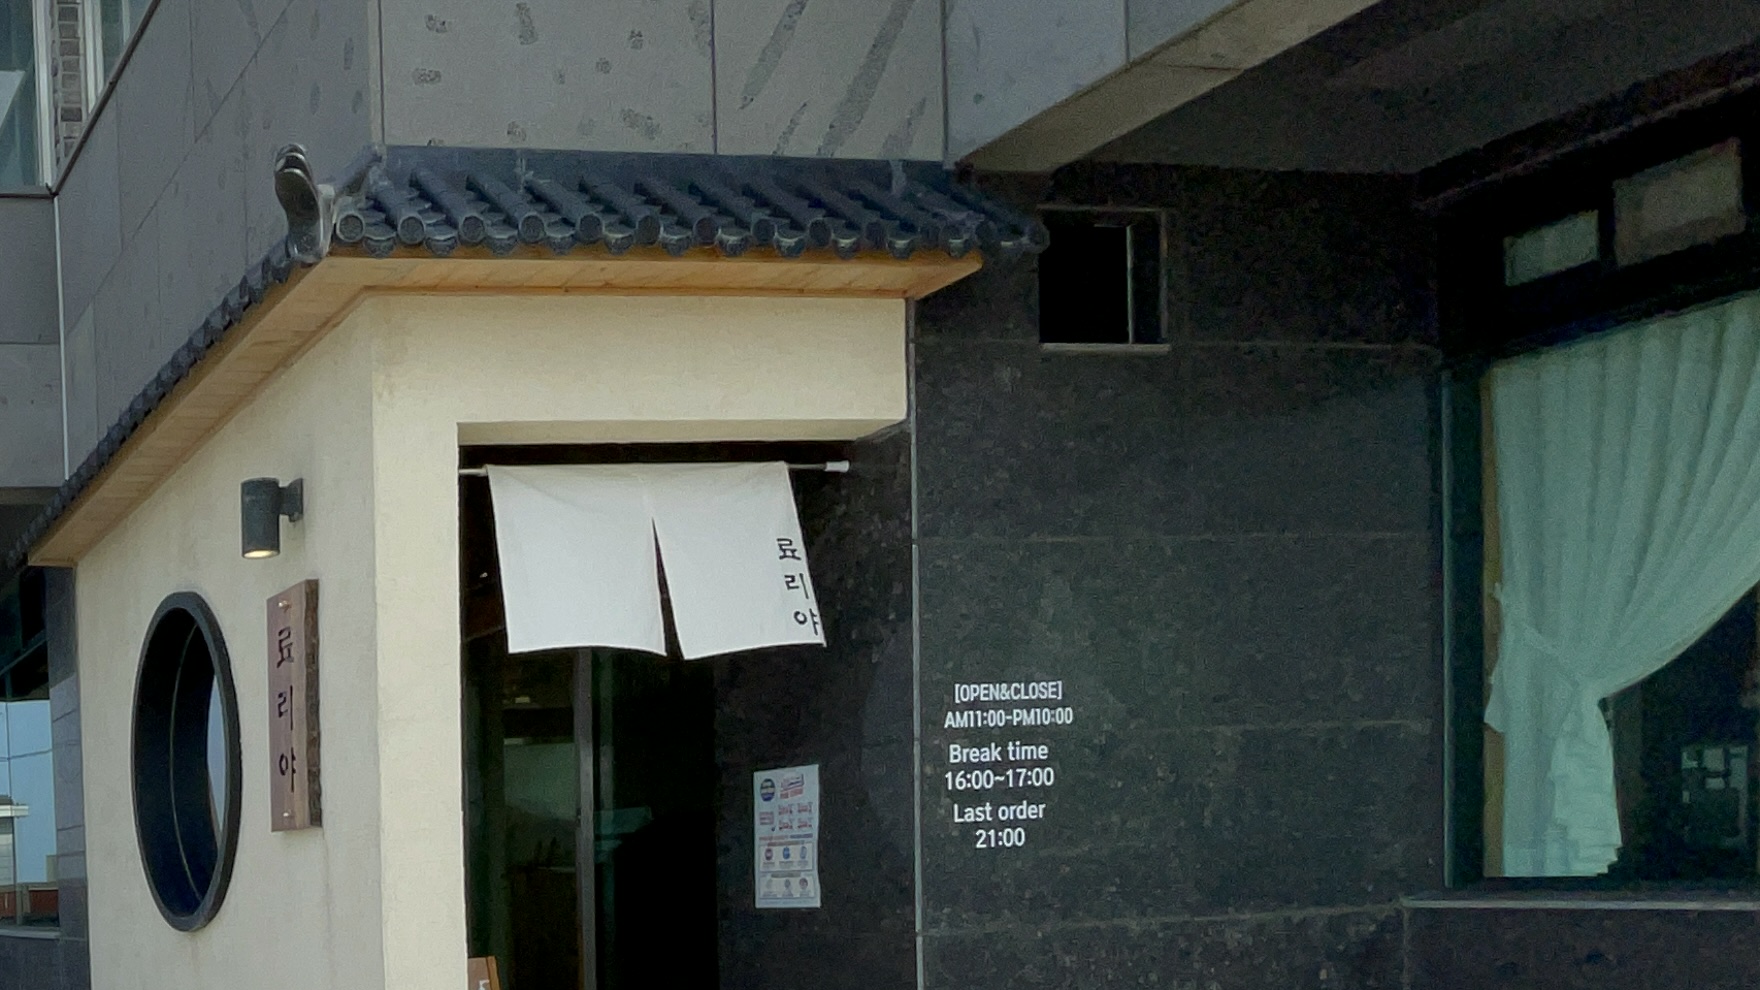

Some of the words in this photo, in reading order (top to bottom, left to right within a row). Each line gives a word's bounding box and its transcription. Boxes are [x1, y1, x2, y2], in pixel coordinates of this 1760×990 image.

[776, 538, 820, 636] 료리야
[954, 680, 1063, 704] [OPEN&CLOSE]
[276, 627, 297, 794] 료리야
[944, 706, 1073, 729] AM11:00-PM10:00
[949, 742, 1002, 764] Break
[1007, 740, 1048, 761] time
[944, 767, 1054, 791] 16:00~17:00
[953, 802, 993, 823] Last
[998, 800, 1046, 821] order
[975, 827, 1025, 849] 21:00
